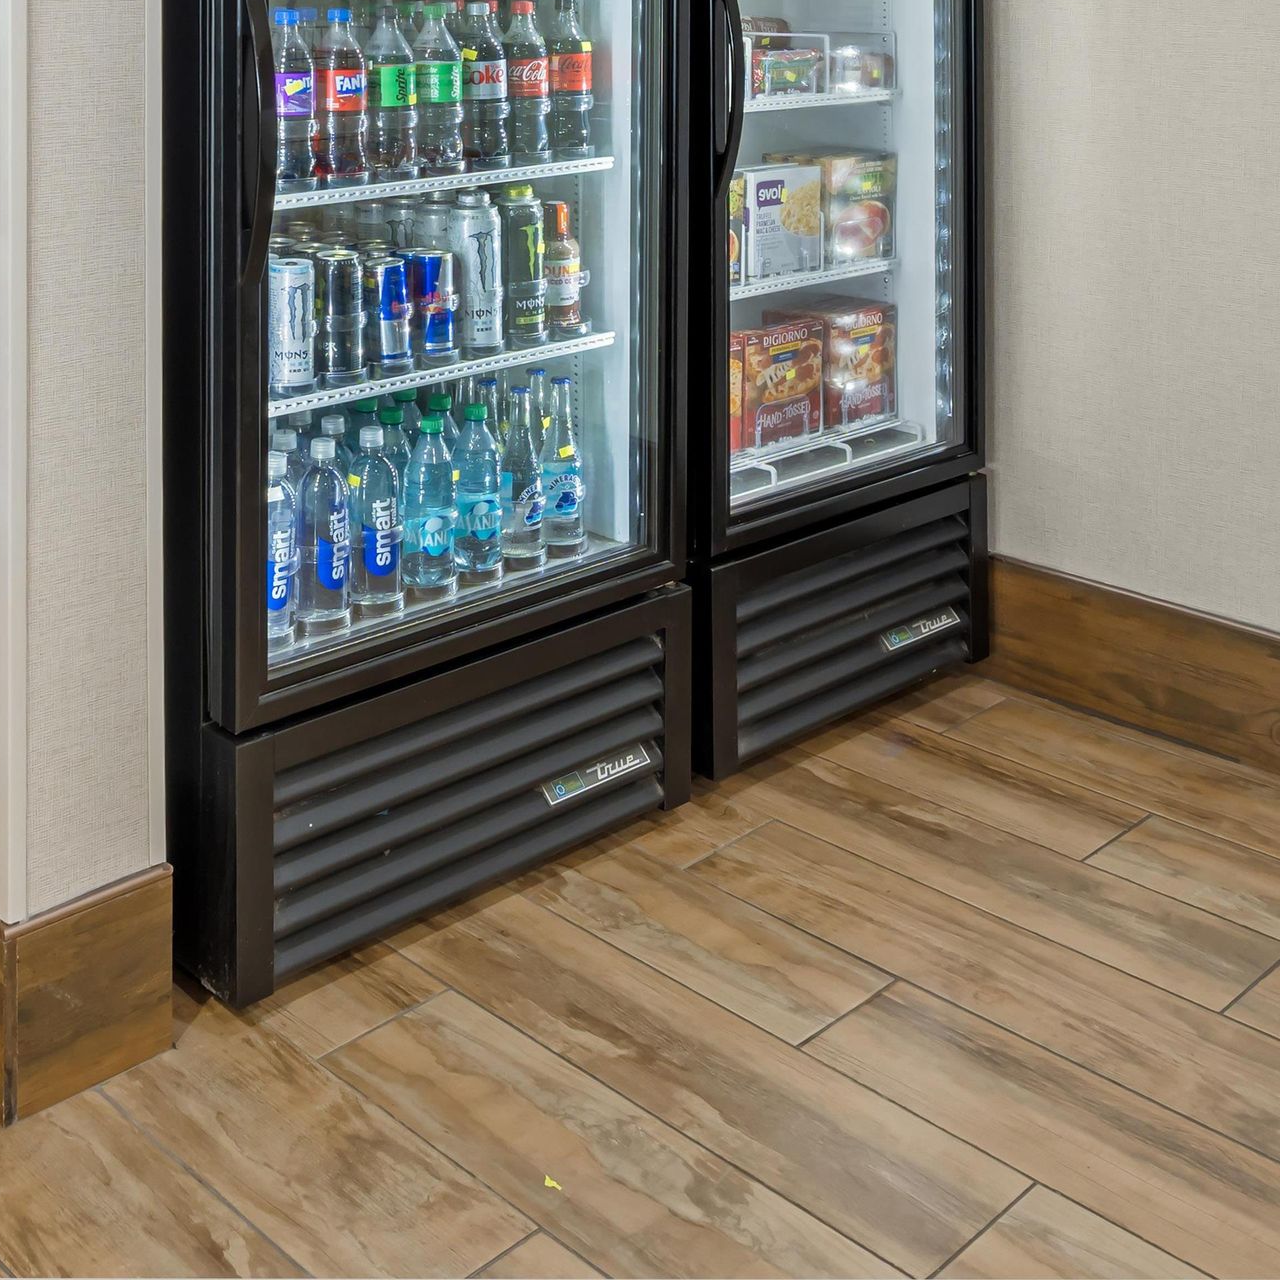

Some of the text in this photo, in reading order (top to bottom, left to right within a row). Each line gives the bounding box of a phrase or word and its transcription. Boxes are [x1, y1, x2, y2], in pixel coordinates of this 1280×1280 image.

[396, 69, 407, 102] Sprite
[451, 65, 460, 99] Sprite
[516, 298, 545, 309] MONS
[763, 328, 808, 346] DIGIORNO
[760, 401, 811, 427] HAND-TOSSED
[332, 509, 346, 580] smart
[373, 498, 392, 566] smart
[272, 530, 291, 600] smart
[912, 613, 952, 633] true
[587, 754, 641, 780] true
